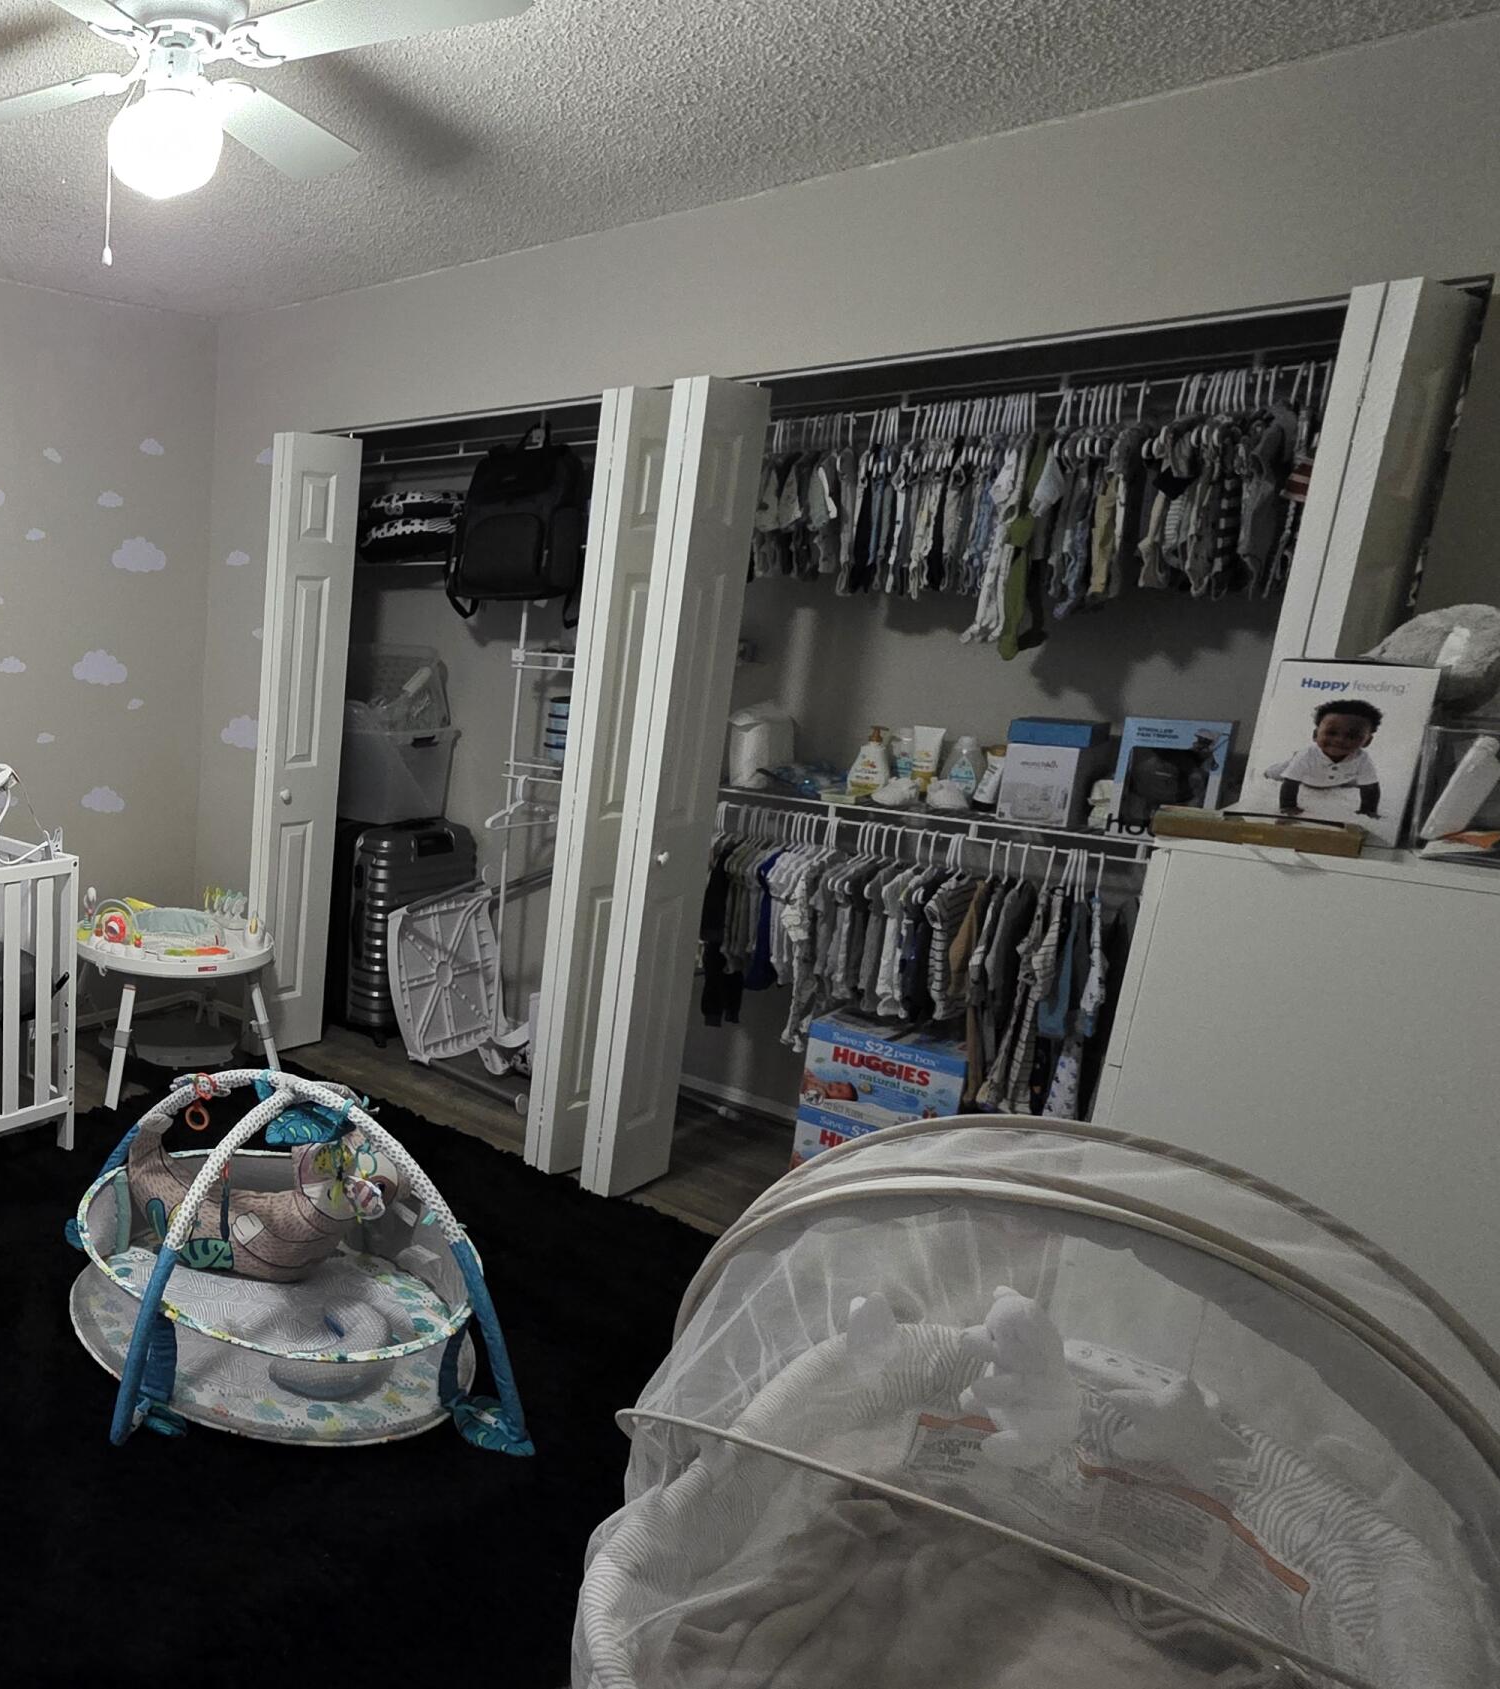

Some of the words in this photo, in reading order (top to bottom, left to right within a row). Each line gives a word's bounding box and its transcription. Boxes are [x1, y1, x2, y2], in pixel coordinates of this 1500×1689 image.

[1300, 677, 1350, 692] Happy
[1352, 680, 1406, 696] feeding
[864, 1040, 894, 1058] $22
[832, 1045, 931, 1087] HUGGIES
[858, 1073, 900, 1089] natural
[902, 1085, 929, 1098] care
